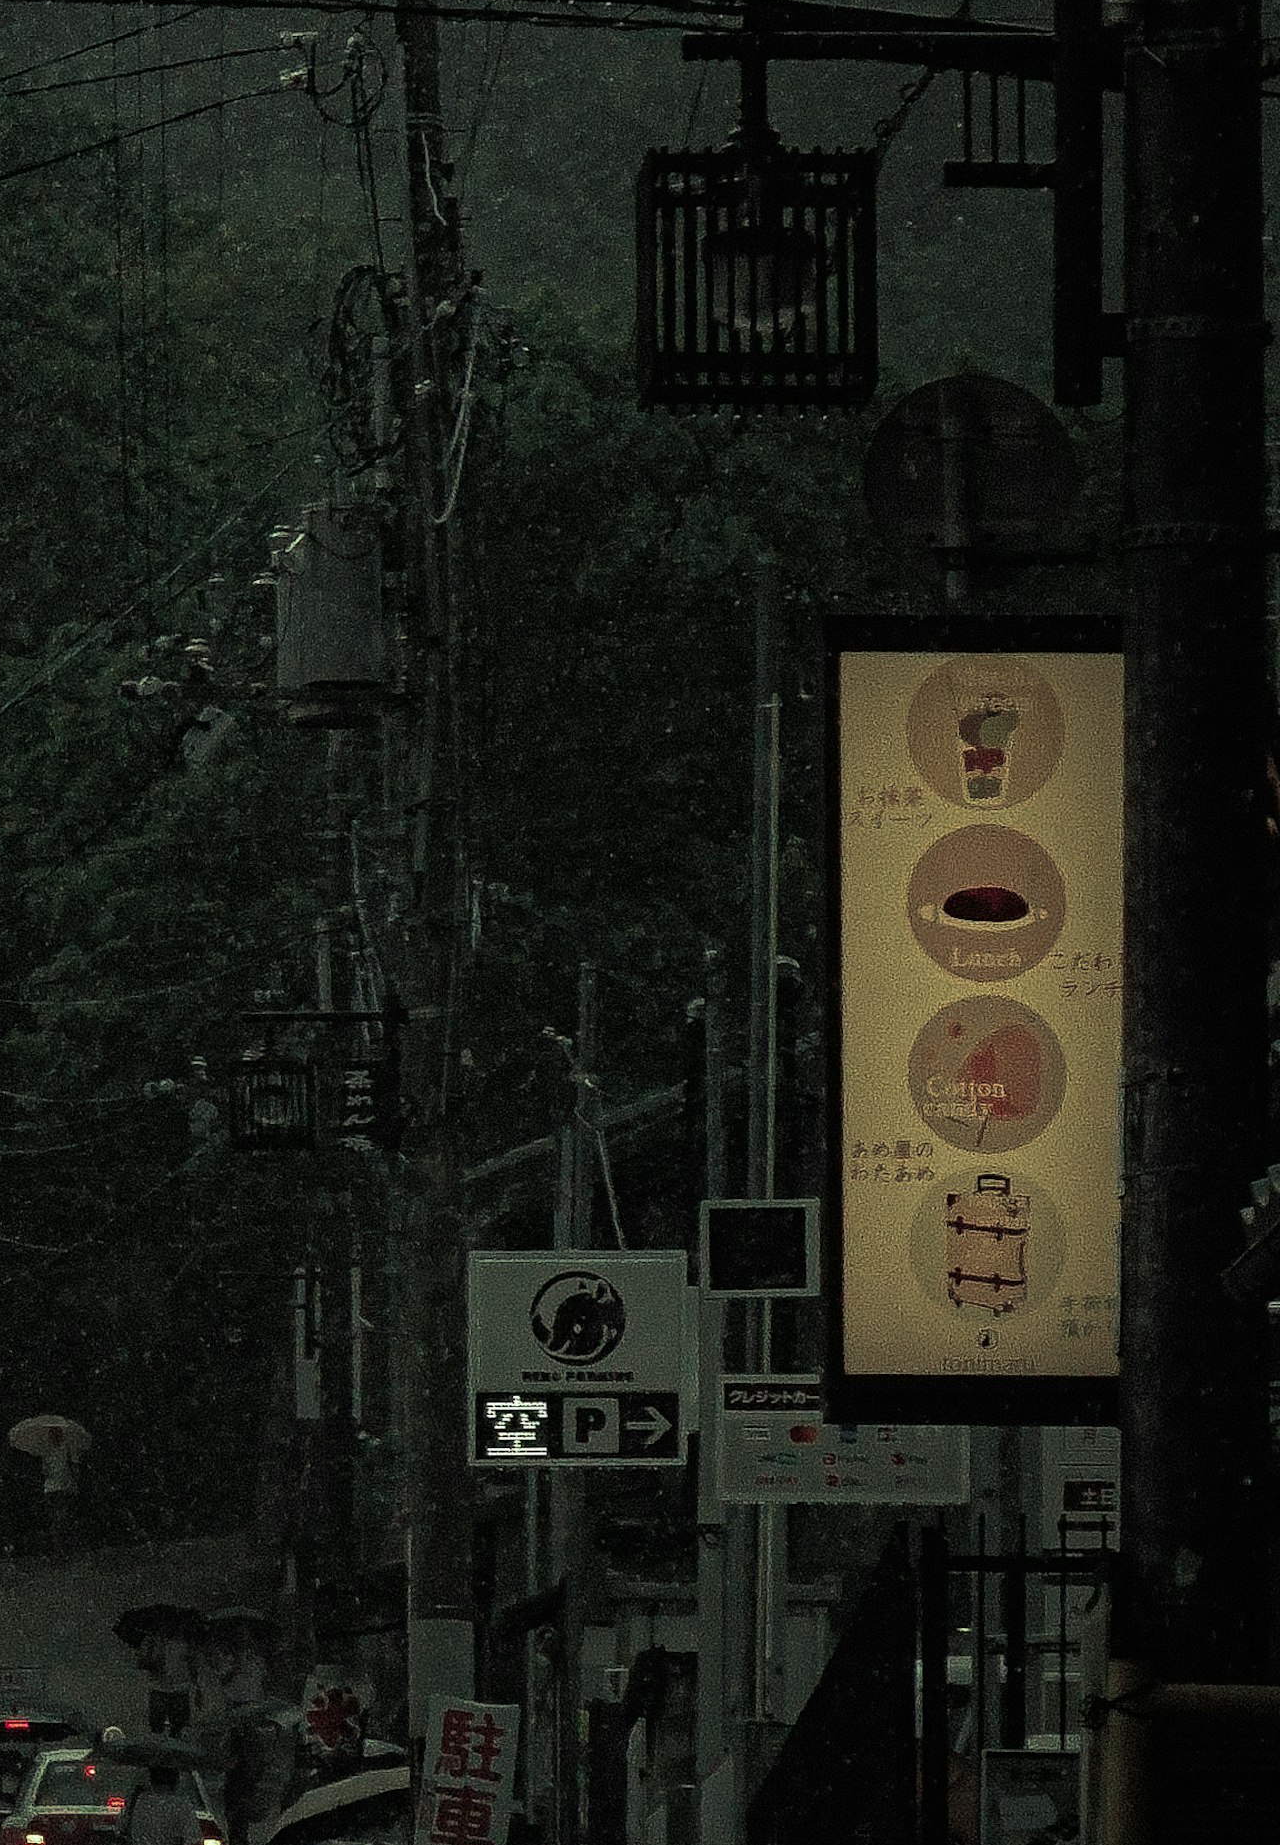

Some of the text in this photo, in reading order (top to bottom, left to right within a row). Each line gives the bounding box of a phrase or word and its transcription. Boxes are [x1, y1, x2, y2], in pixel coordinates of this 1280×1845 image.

[951, 947, 1022, 969] Lunch
[925, 1074, 1007, 1102] Cotton
[486, 1394, 549, 1457] 空
[575, 1406, 607, 1444] P
